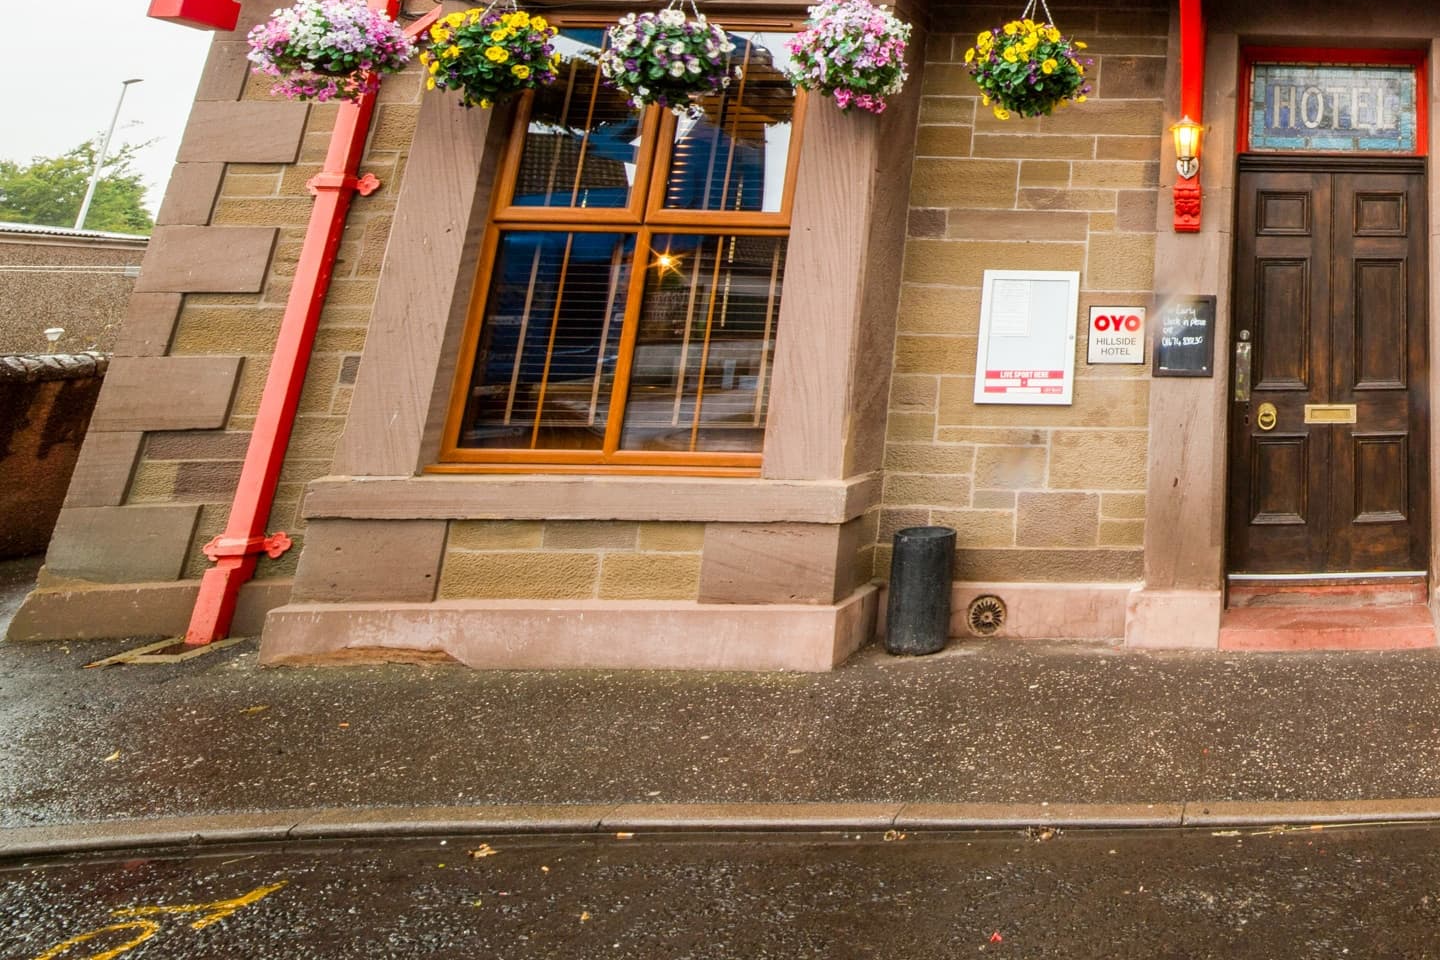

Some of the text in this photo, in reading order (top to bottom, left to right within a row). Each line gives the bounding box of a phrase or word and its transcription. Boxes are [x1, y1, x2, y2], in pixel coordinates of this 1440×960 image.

[1273, 85, 1397, 130] HOTEL
[1094, 314, 1141, 331] OYO
[1096, 337, 1136, 346] HILLSIDE
[1101, 347, 1131, 356] HOTEL
